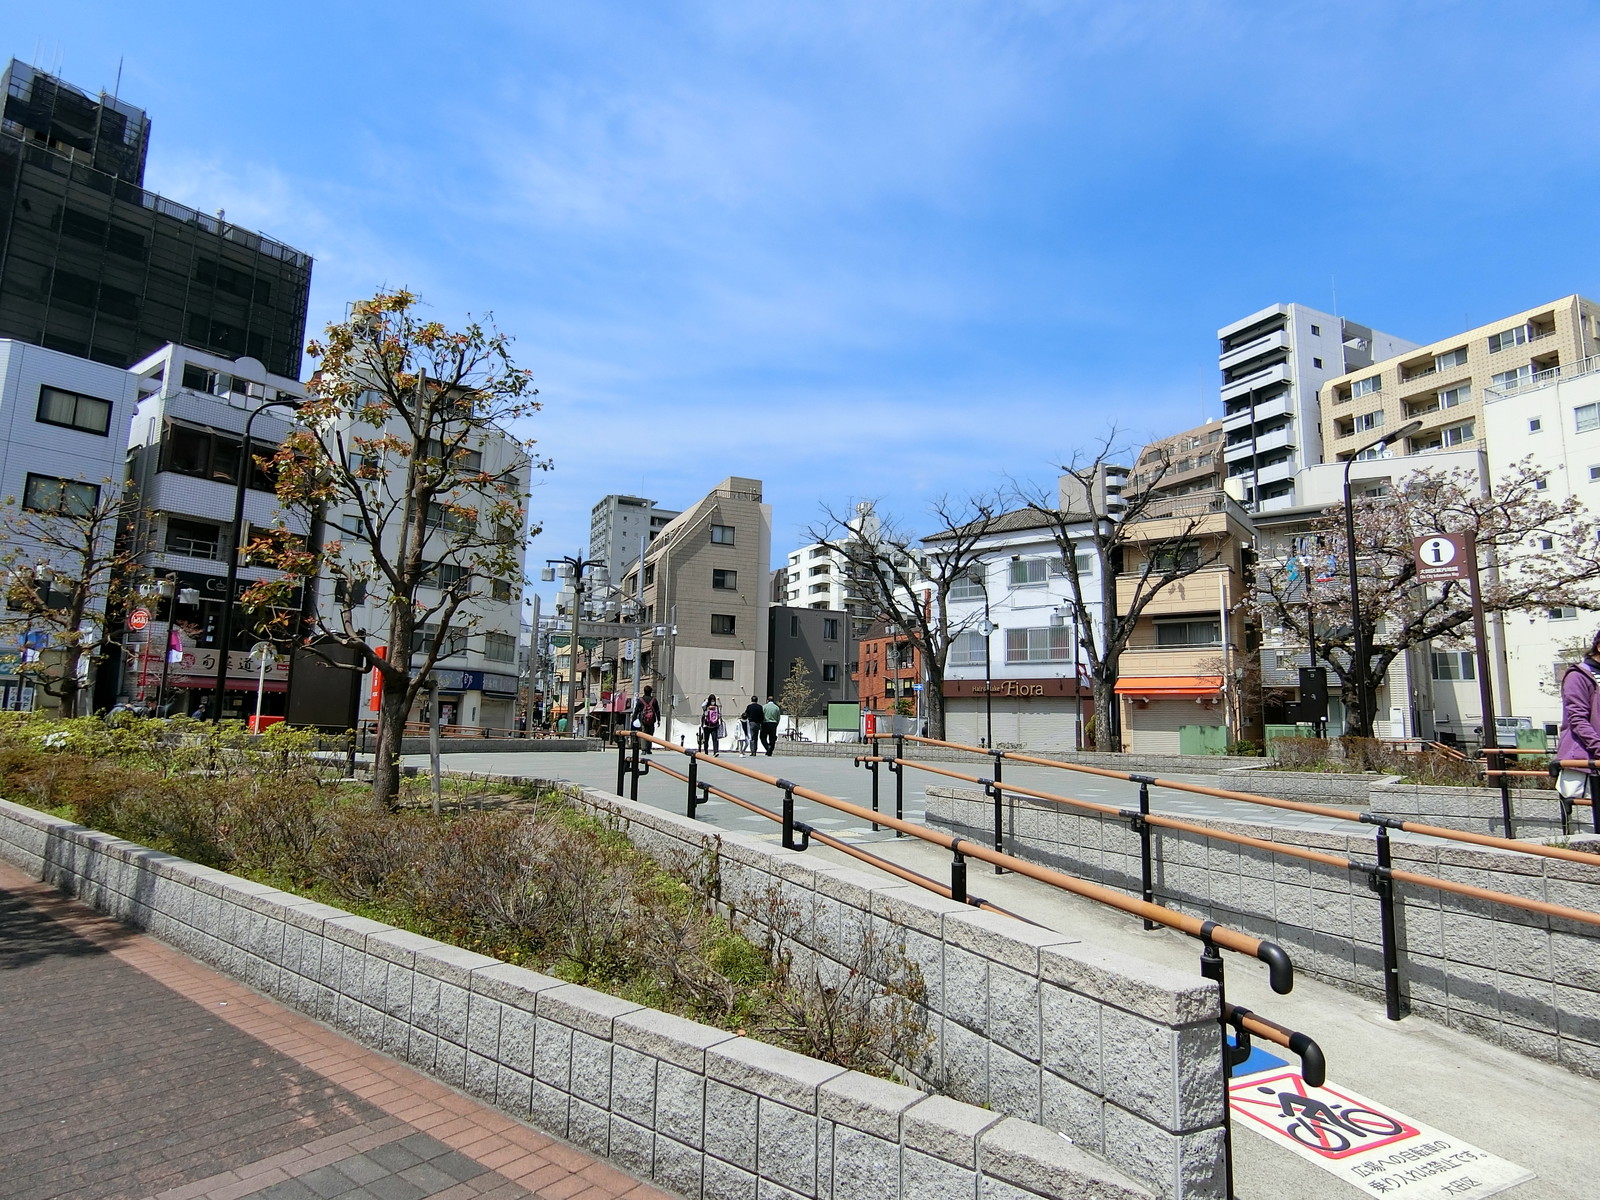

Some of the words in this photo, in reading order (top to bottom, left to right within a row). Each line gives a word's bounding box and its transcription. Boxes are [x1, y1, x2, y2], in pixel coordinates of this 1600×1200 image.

[1001, 680, 1044, 696] Fiora
[1351, 1140, 1451, 1178] 広場への自転車の
[1368, 1150, 1488, 1194] 乗り入れは禁止です。
[1441, 1176, 1483, 1196] 大田区
